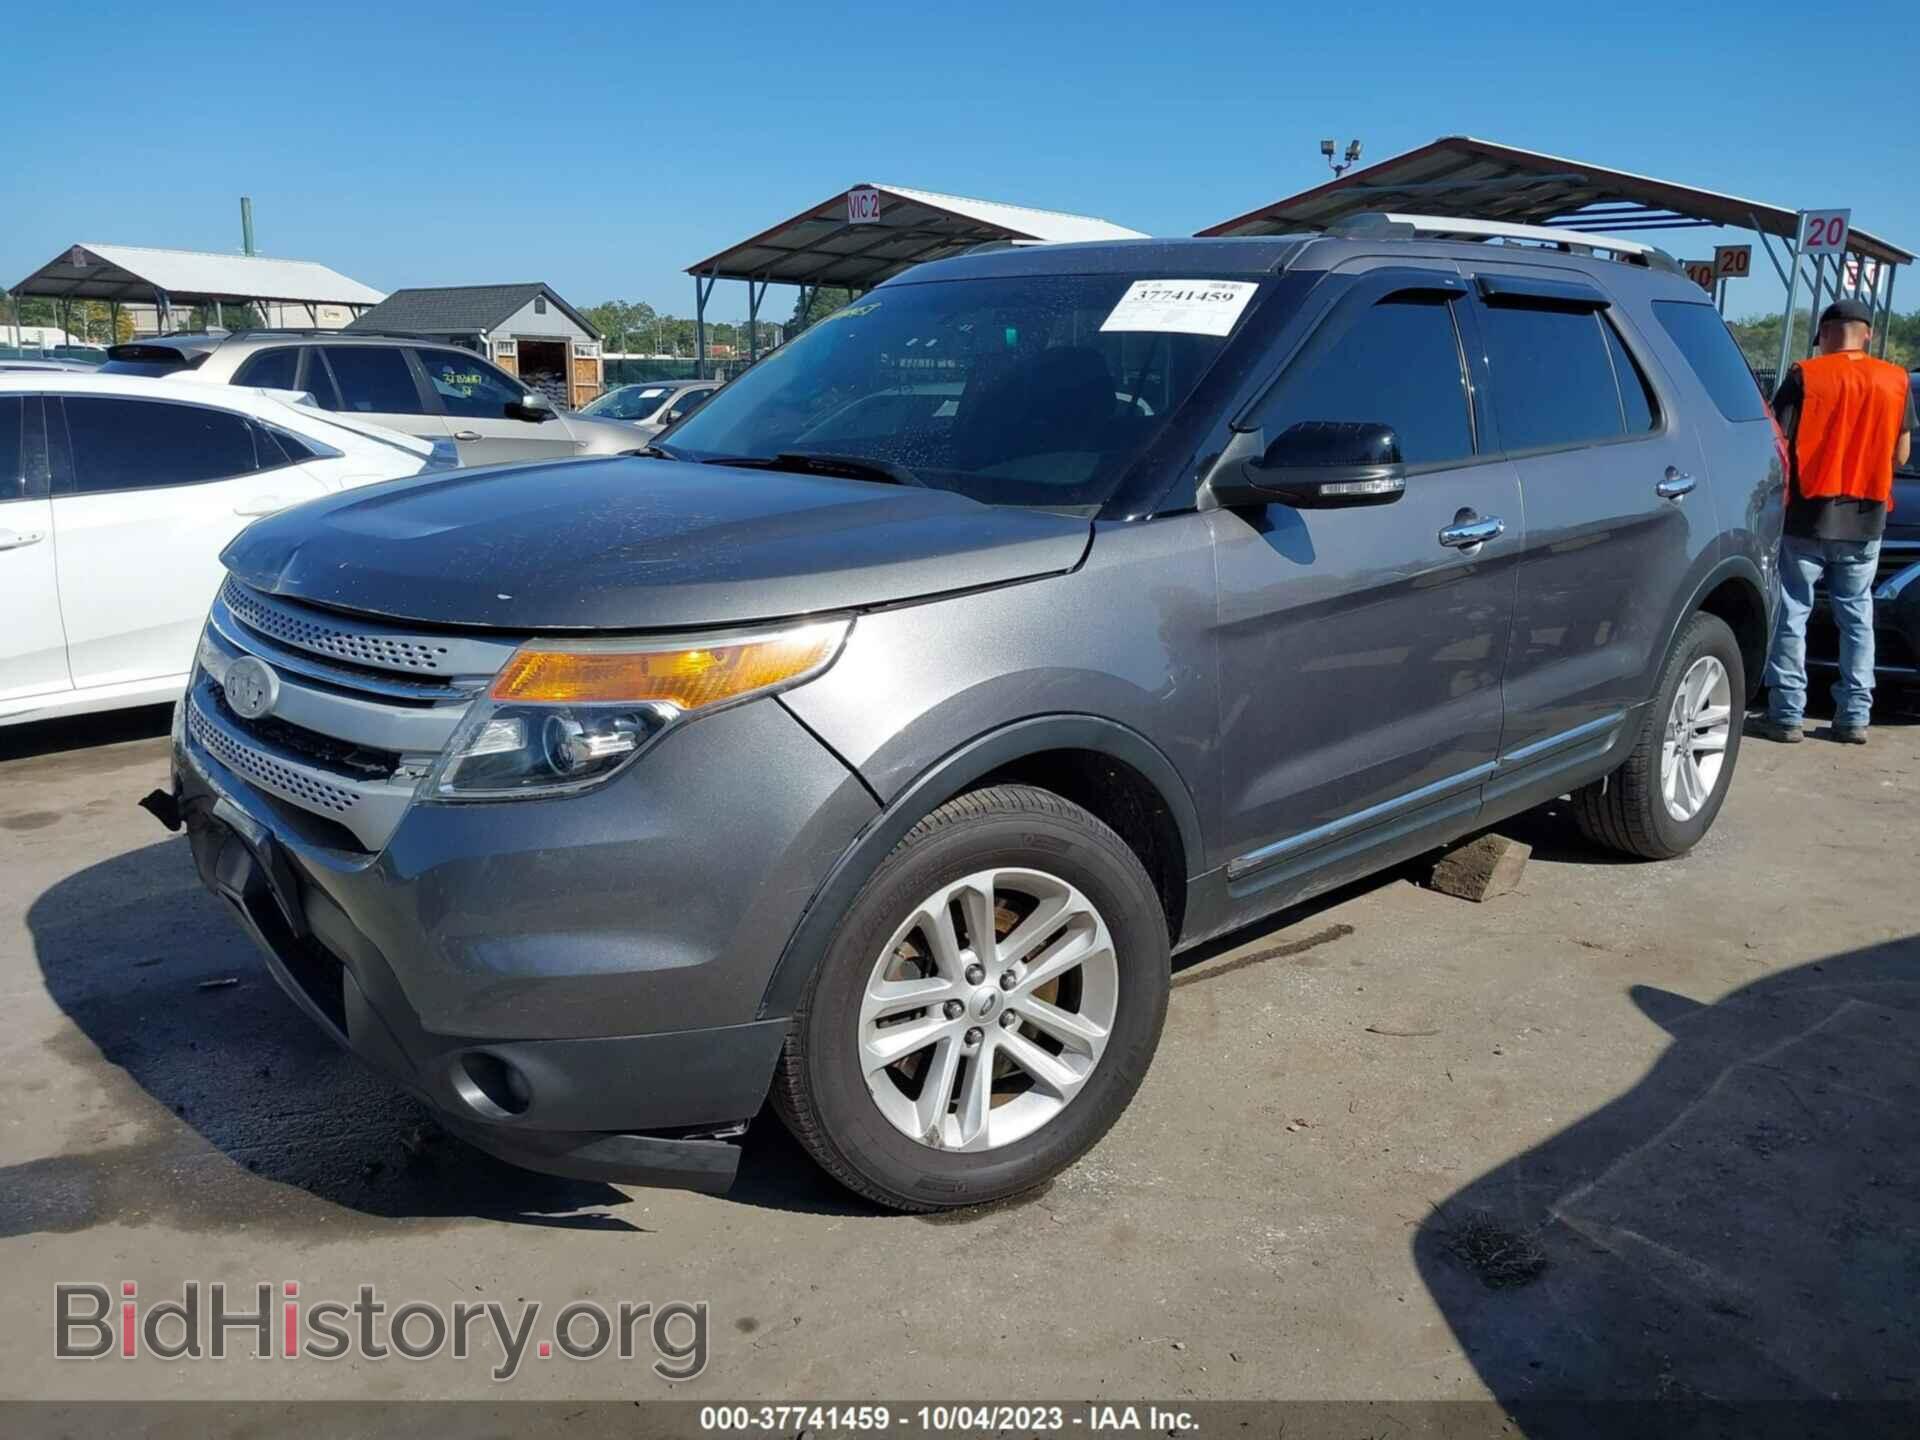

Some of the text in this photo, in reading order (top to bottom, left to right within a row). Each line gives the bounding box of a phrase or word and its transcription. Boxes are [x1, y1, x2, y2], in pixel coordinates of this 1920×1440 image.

[849, 194, 879, 218] VIC 2
[1807, 217, 1844, 246] 20
[1721, 251, 1748, 272] 20
[1133, 290, 1235, 303] 37741459
